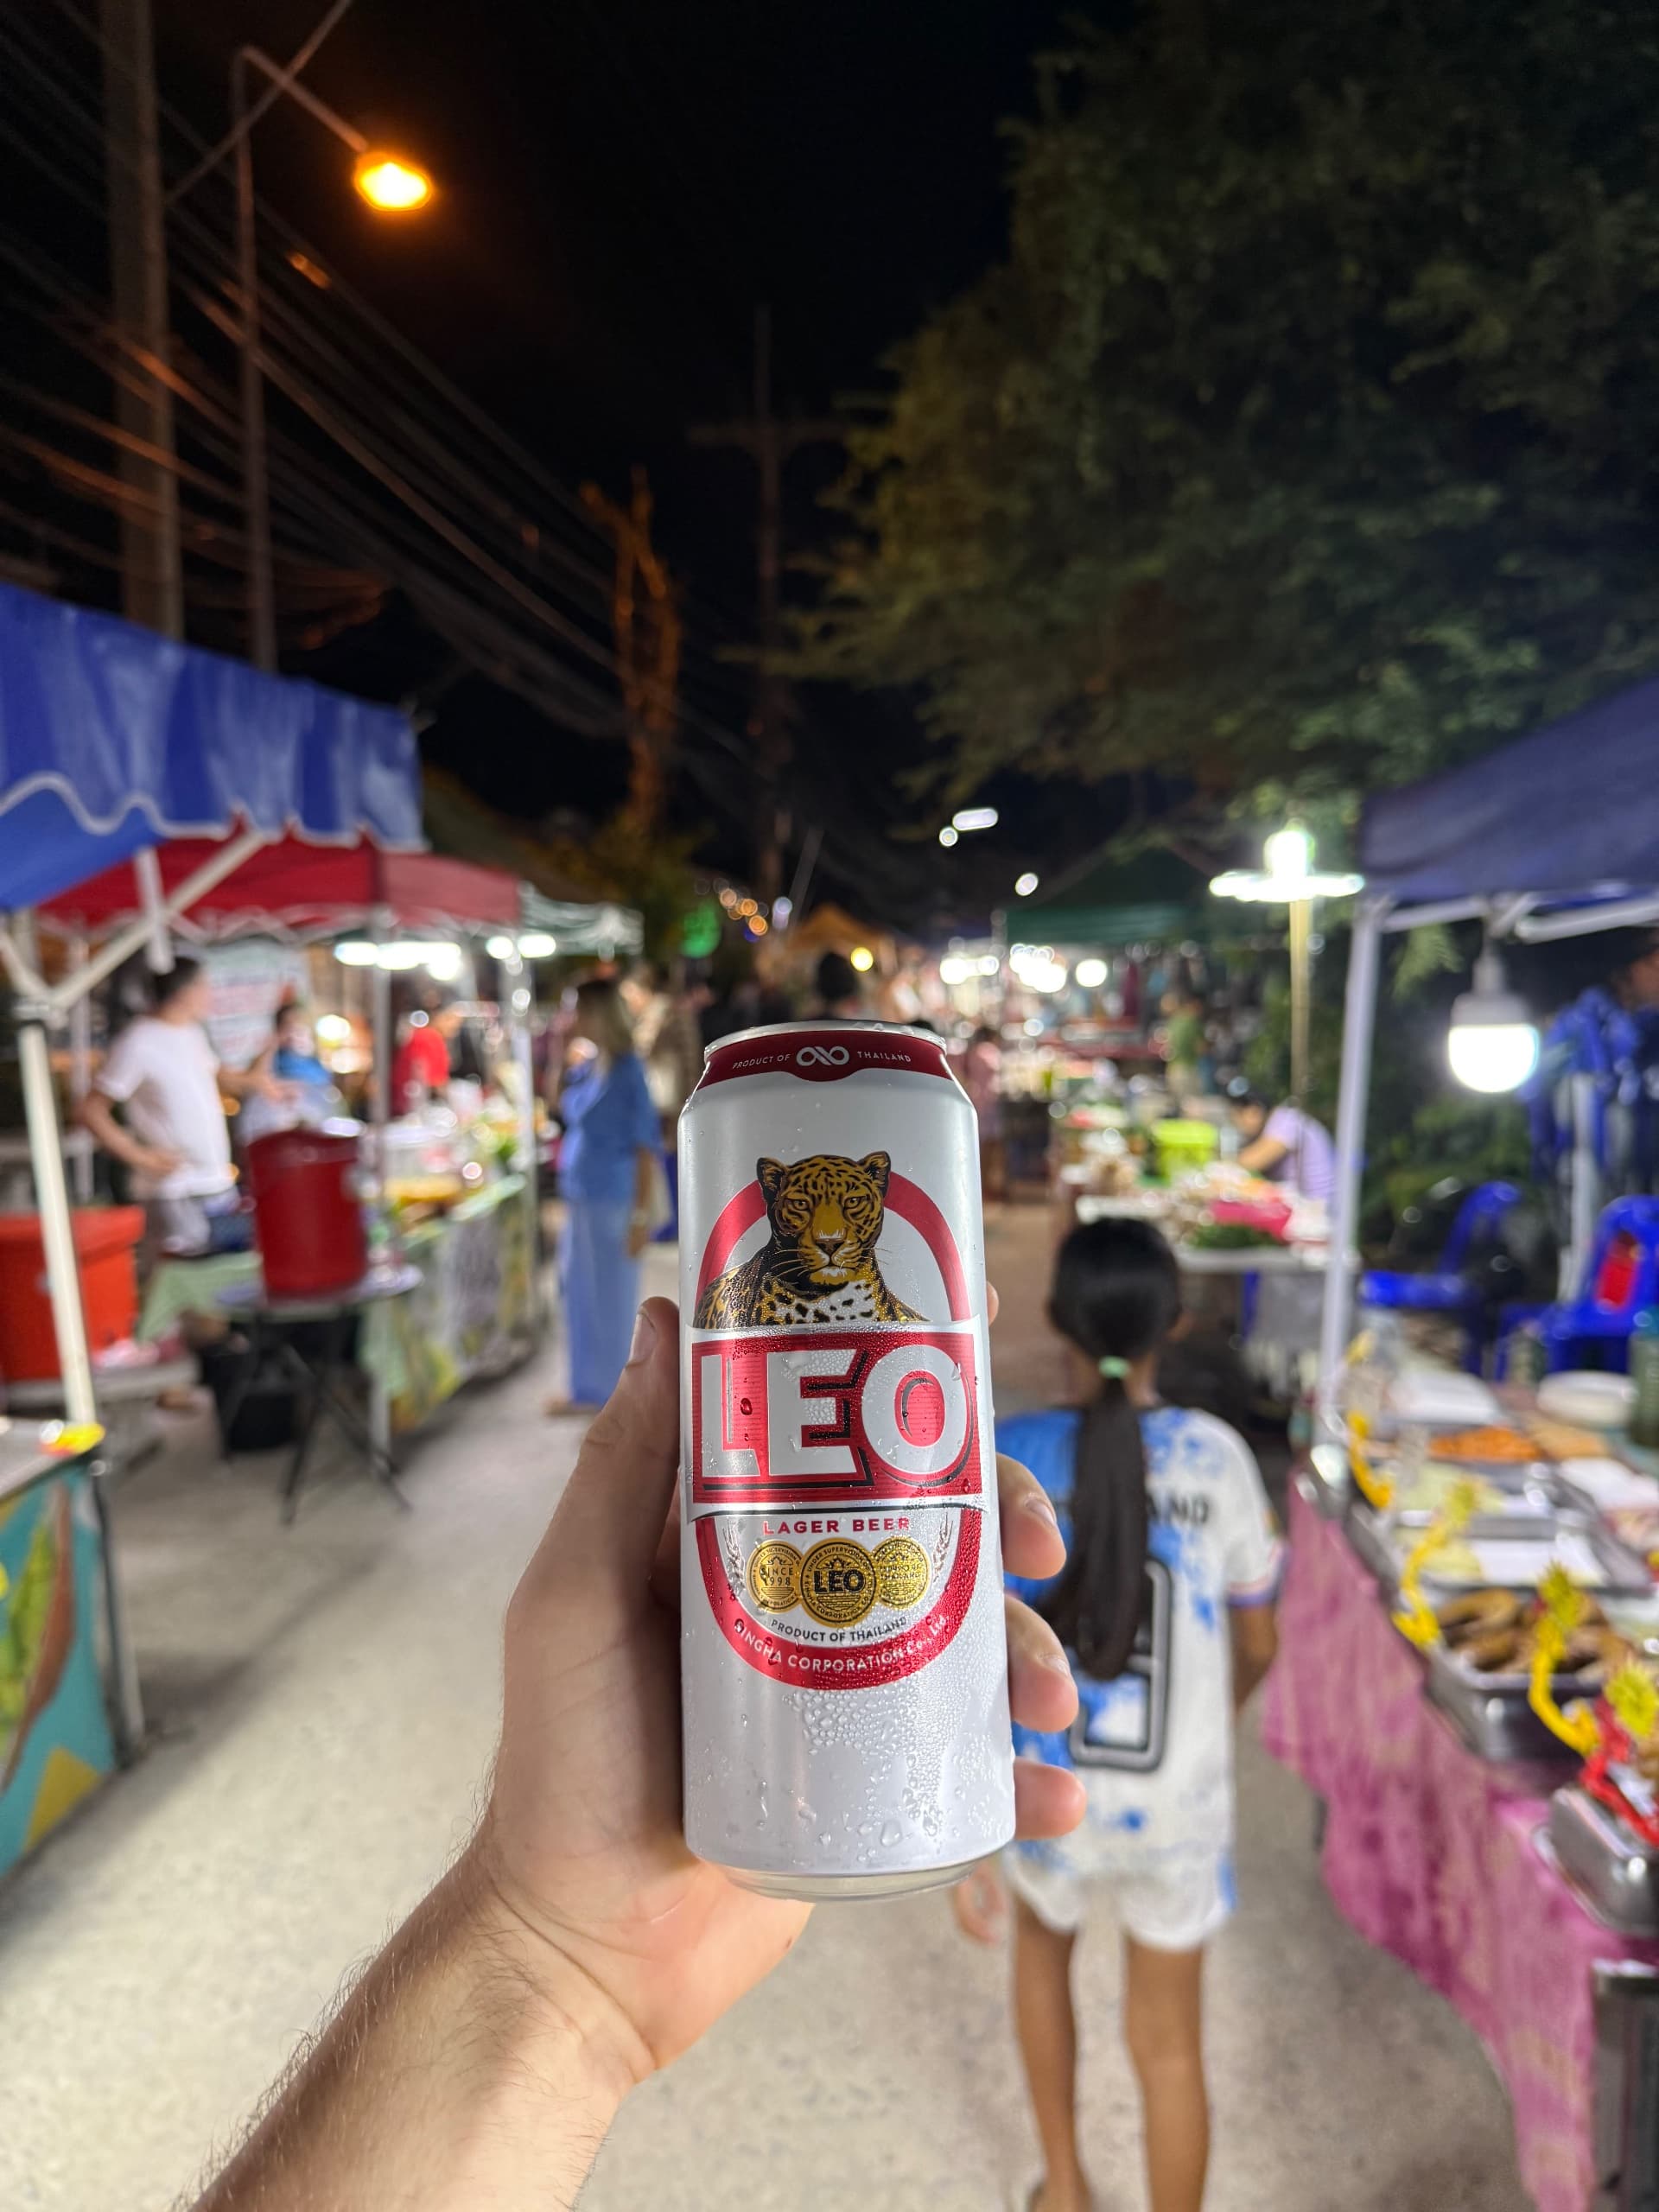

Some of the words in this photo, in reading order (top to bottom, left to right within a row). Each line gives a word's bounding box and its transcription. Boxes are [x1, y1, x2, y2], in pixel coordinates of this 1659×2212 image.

[733, 1056, 773, 1070] PRODUCT
[778, 1053, 791, 1063] OF
[857, 1051, 912, 1063] THAILAND
[701, 1344, 967, 1478] LEO
[763, 1520, 840, 1535] LAGER
[853, 1517, 910, 1532] BEER
[760, 1567, 793, 1576] SINCE
[814, 1569, 865, 1592] LEO
[771, 1619, 826, 1642] PRODUCT
[830, 1630, 847, 1643] OF
[850, 1617, 907, 1642] THAILAND
[734, 1619, 782, 1663] INGHA
[787, 1648, 905, 1672] CORPORATION
